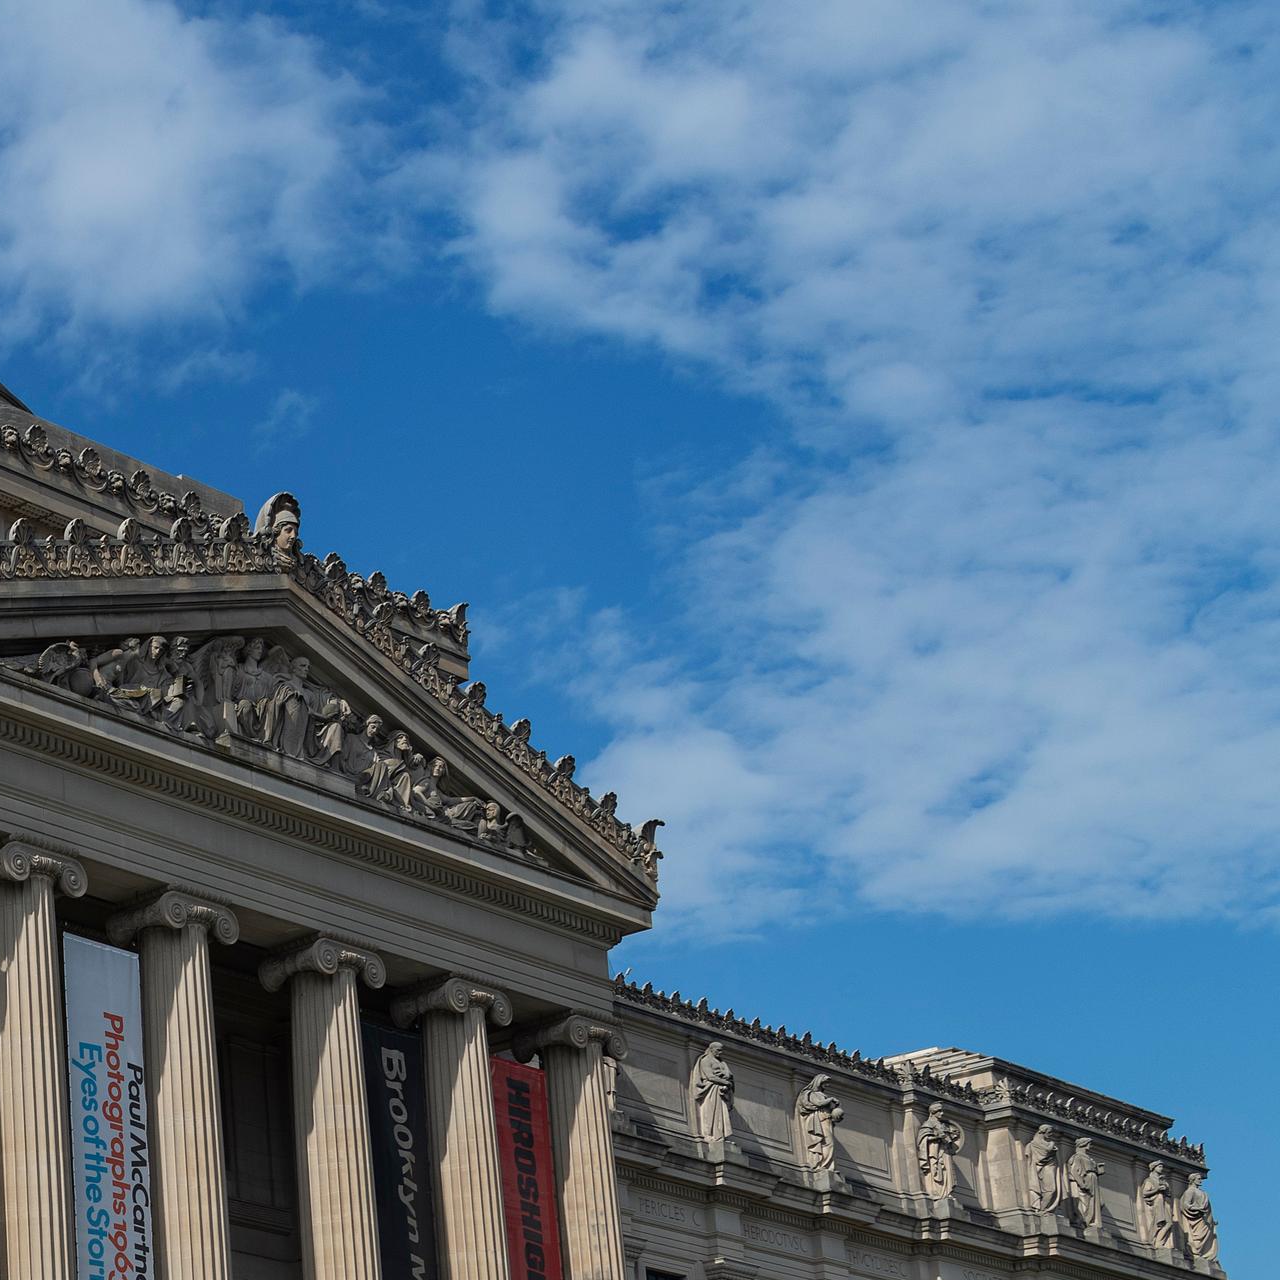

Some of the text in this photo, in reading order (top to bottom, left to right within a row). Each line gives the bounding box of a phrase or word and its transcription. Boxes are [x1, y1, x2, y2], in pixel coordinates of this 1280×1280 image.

[71, 1040, 103, 1112] Eyes
[127, 1061, 146, 1131] Paul
[82, 1115, 107, 1152] of
[102, 1011, 132, 1216] Photographs
[381, 1046, 419, 1244] Brooklyn
[84, 1152, 108, 1203] the
[638, 1196, 686, 1222] PERICLES
